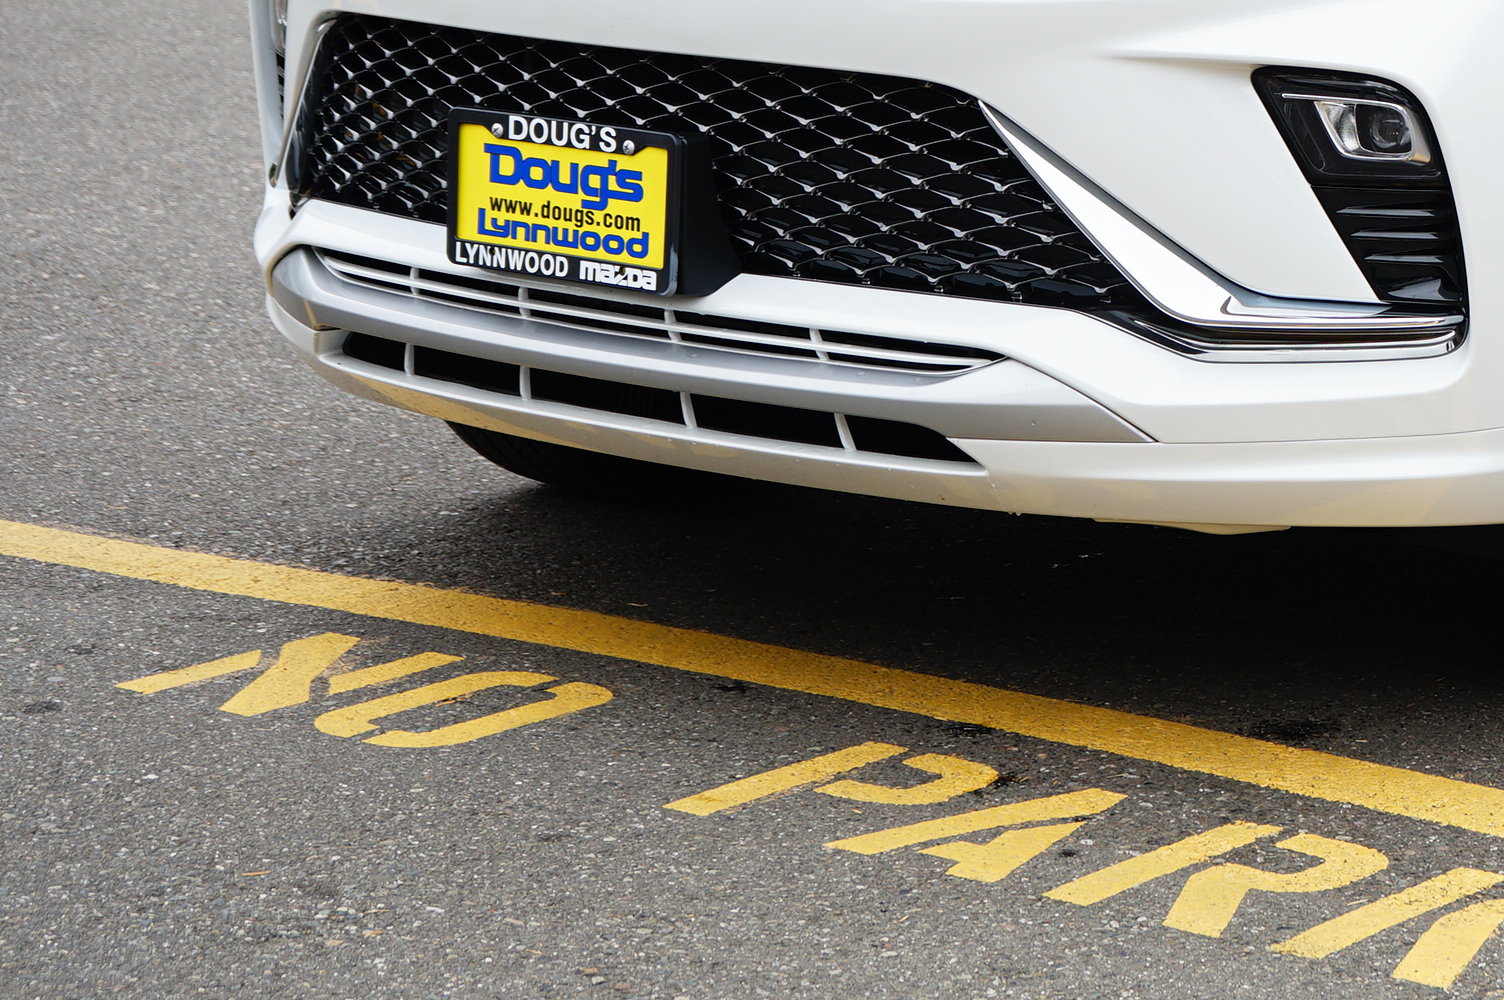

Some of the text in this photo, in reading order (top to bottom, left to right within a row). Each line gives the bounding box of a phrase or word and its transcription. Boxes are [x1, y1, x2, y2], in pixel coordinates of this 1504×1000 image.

[508, 115, 617, 153] DOUG'S
[489, 196, 641, 232] www.dougs.com
[477, 208, 650, 259] Lynnwood
[455, 241, 569, 277] LYNNWOOD
[115, 632, 614, 748] NO
